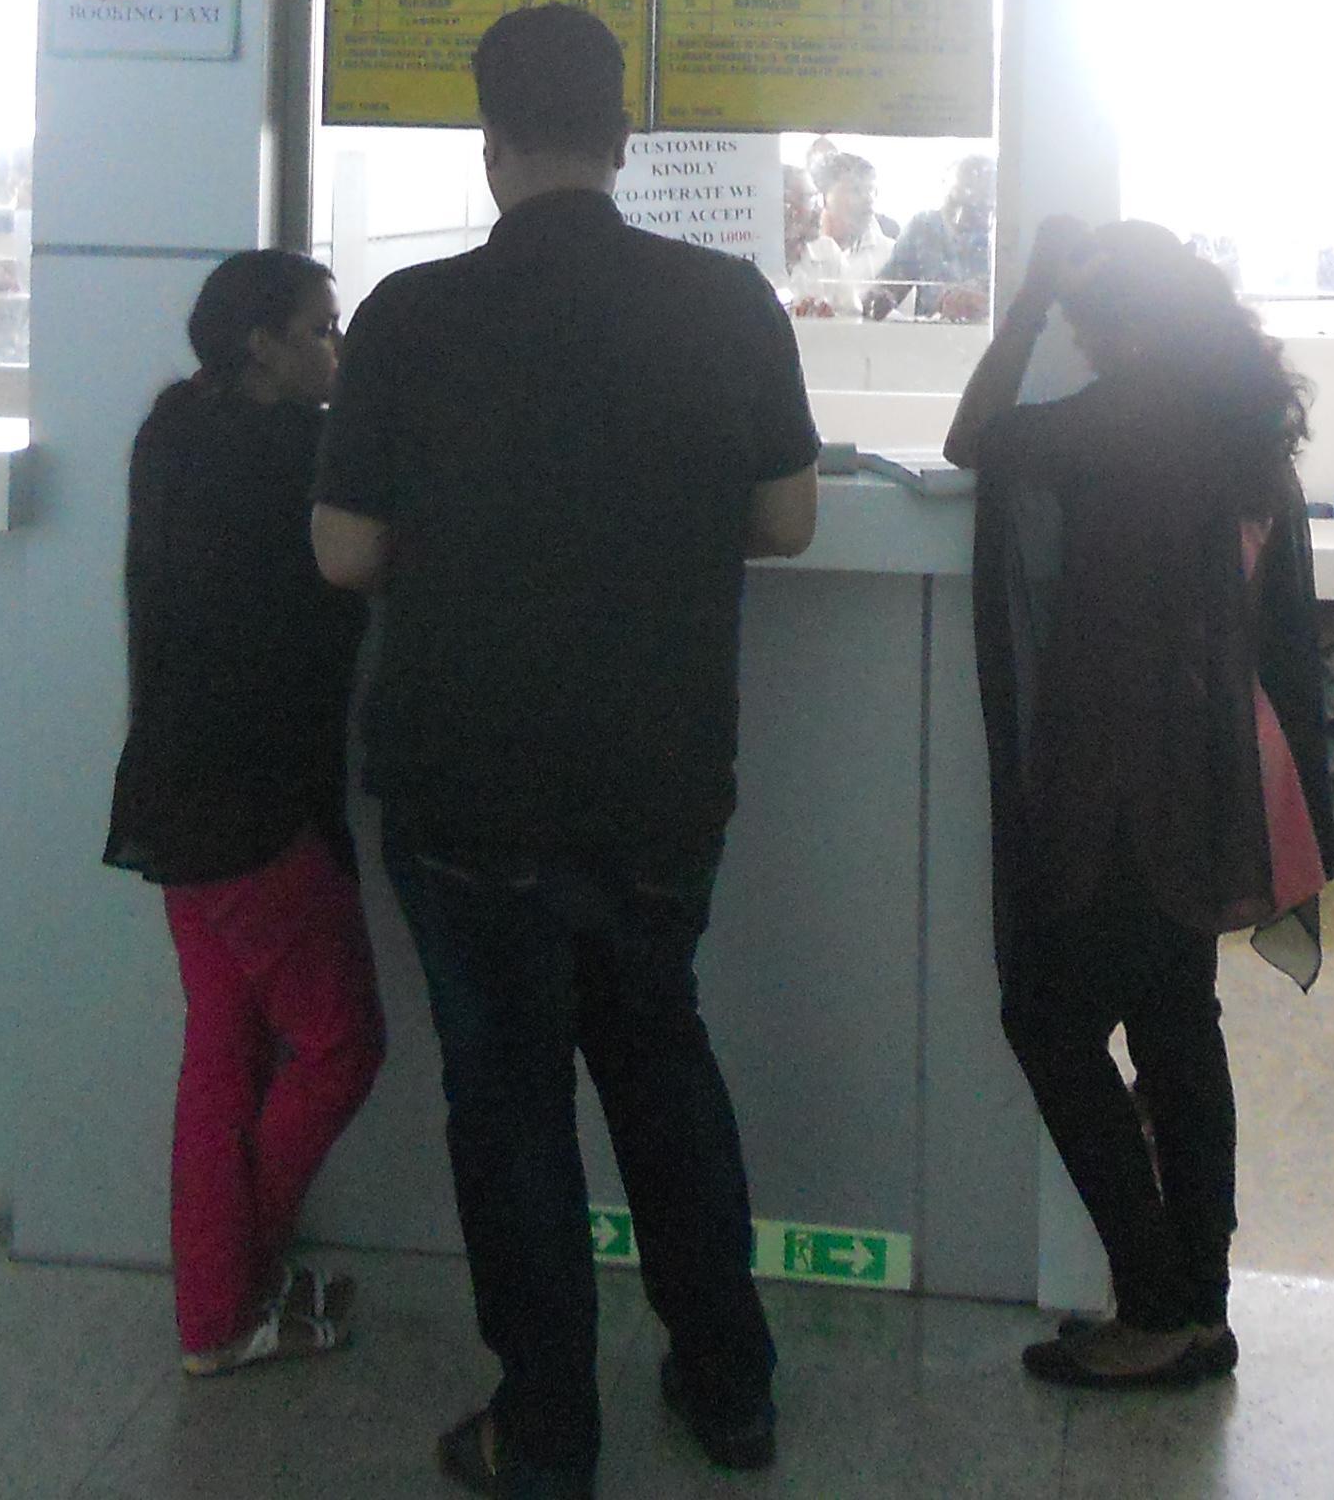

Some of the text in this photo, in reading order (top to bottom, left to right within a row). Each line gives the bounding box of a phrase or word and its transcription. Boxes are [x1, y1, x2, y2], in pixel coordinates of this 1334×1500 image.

[70, 5, 220, 22] BOOKING TAXI
[631, 139, 738, 155] CUSTOMERS
[652, 162, 717, 176] KINDLY
[729, 184, 758, 198] WE
[647, 210, 682, 224] NOT
[688, 208, 755, 221] ACCEPT
